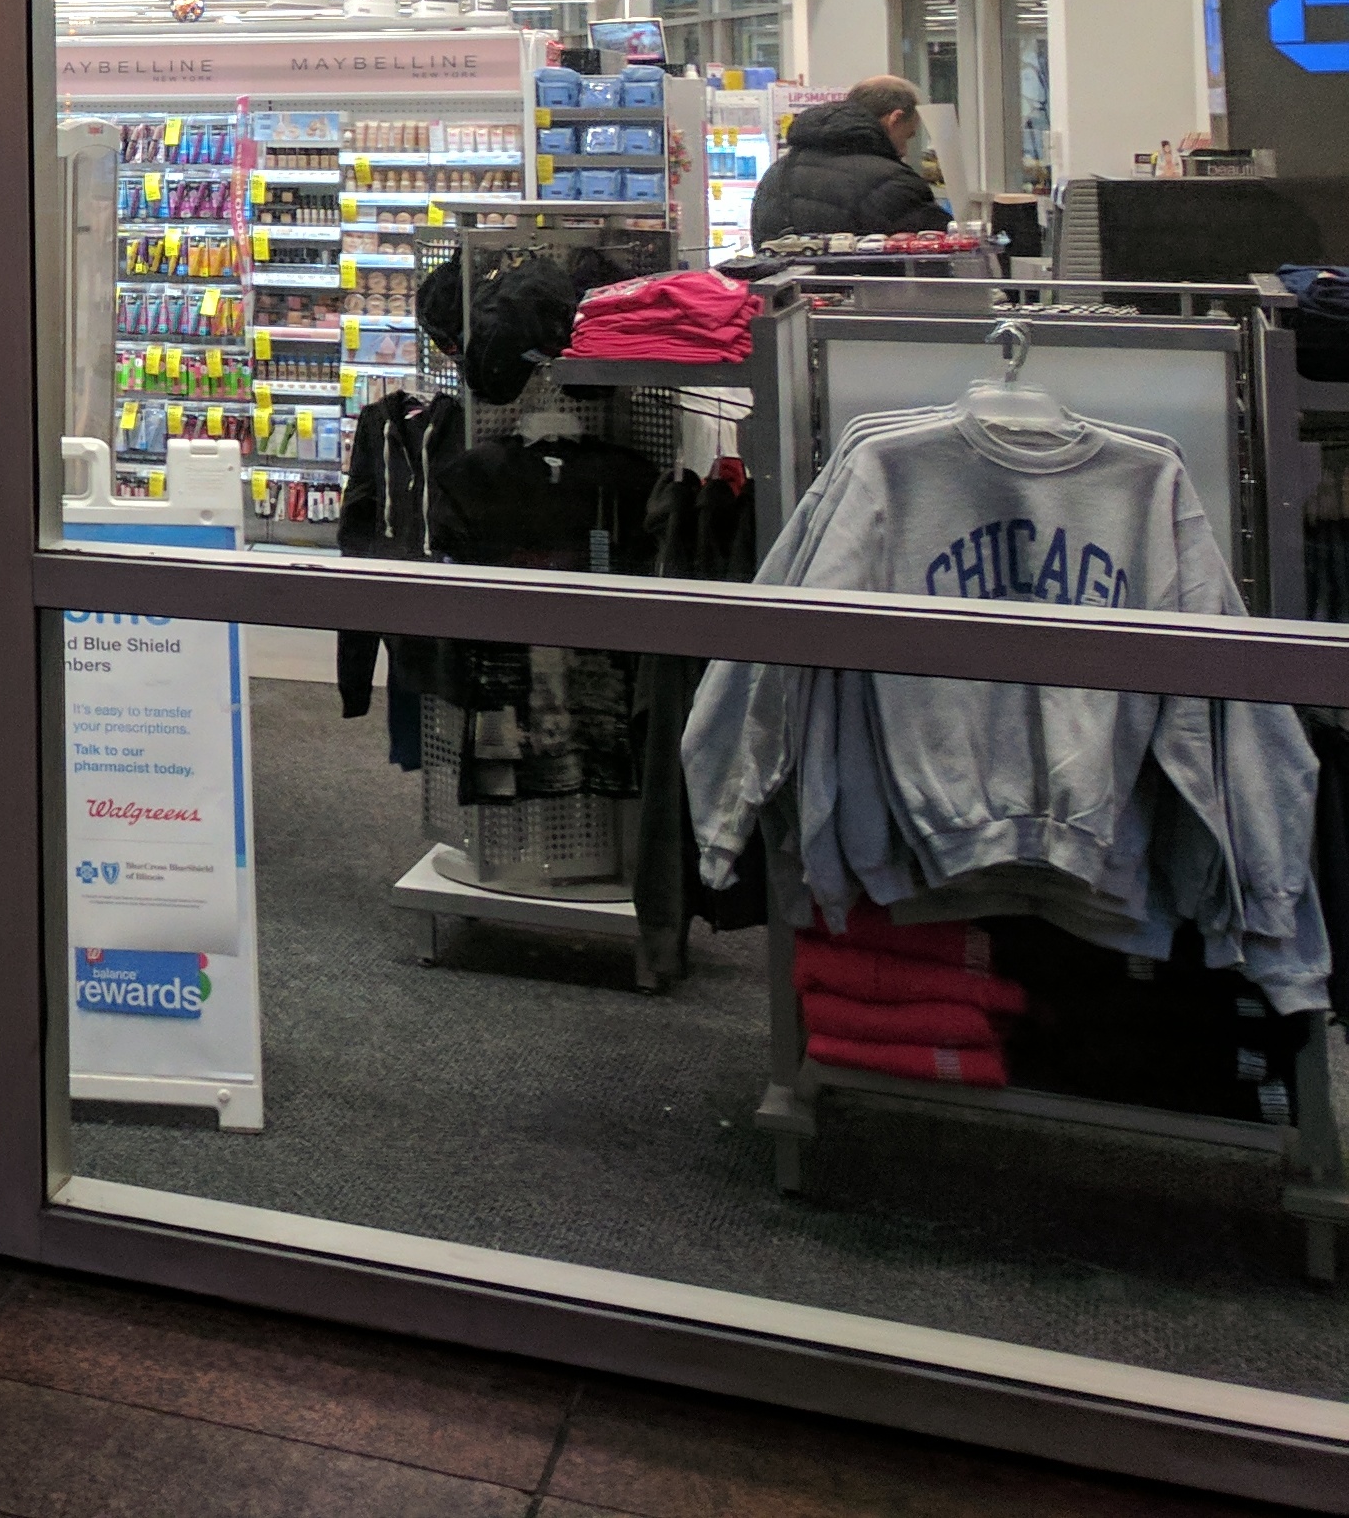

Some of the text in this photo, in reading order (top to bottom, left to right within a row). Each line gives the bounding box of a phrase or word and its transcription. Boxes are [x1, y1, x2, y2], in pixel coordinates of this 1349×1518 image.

[62, 59, 214, 75] AYBELLINE
[291, 54, 478, 71] MAYBELLINE
[83, 636, 122, 652] Blue
[126, 637, 181, 654] Shield
[73, 703, 193, 719] It's easy to transfer
[73, 721, 191, 736] your prescriptions.
[74, 743, 145, 757] Talk to our
[74, 760, 195, 778] pharmacist today.
[86, 798, 201, 826] Walgreens
[93, 969, 136, 980] balance
[76, 977, 202, 1012] rewards
